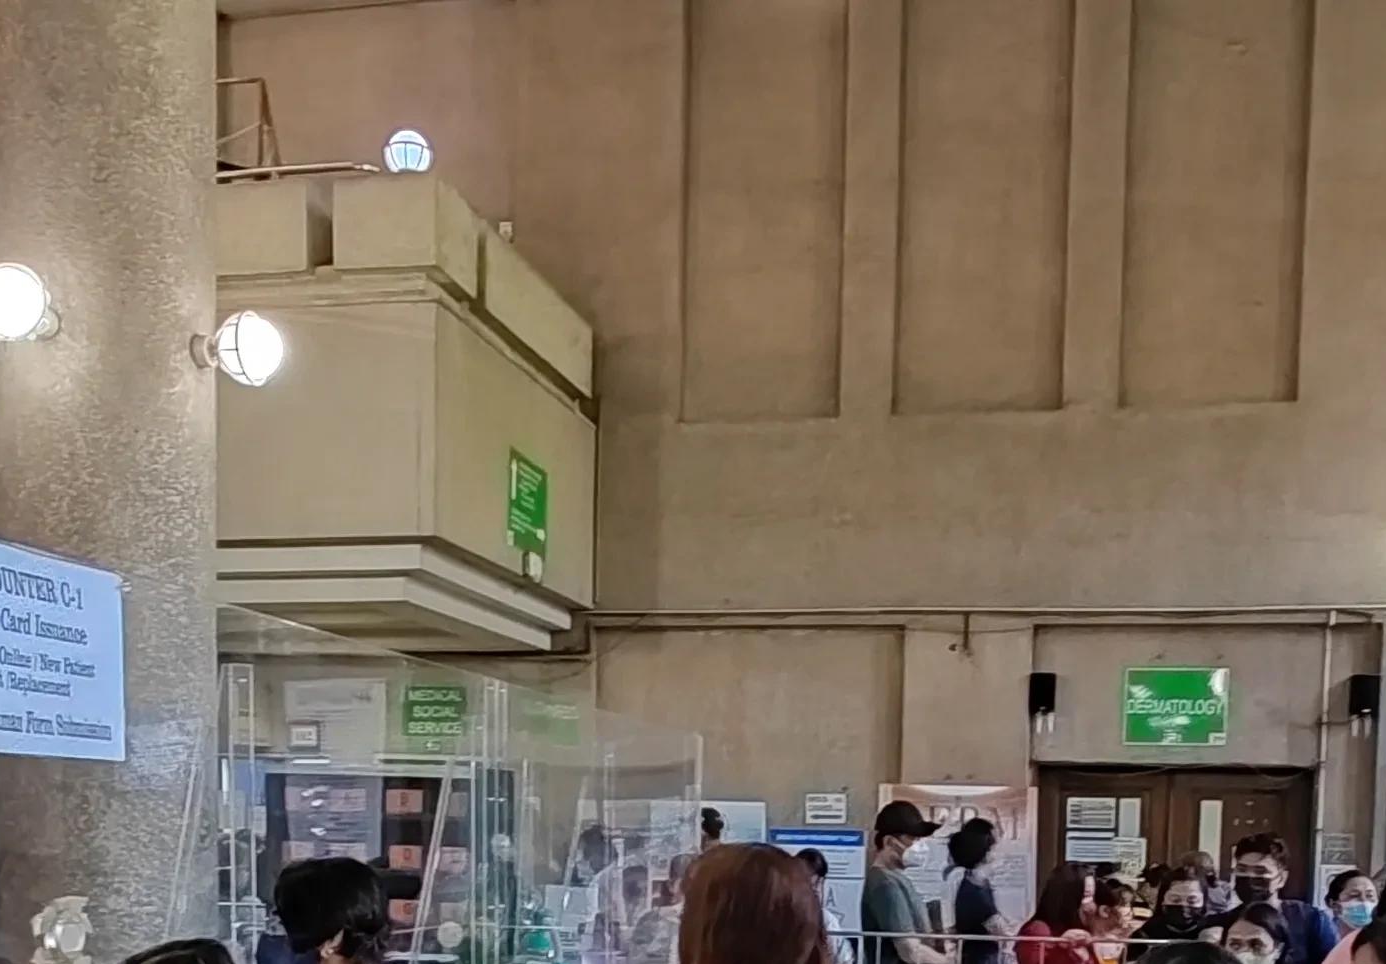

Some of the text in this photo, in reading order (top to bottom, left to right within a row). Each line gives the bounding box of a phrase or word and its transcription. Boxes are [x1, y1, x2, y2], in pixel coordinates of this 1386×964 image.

[60, 581, 84, 610] C-1
[0, 607, 31, 635] Card
[408, 689, 462, 702] MEDICAL
[413, 704, 459, 718] SOCIAL
[1125, 698, 1223, 715] DERMATOLOGY
[408, 720, 462, 734] SERVICE
